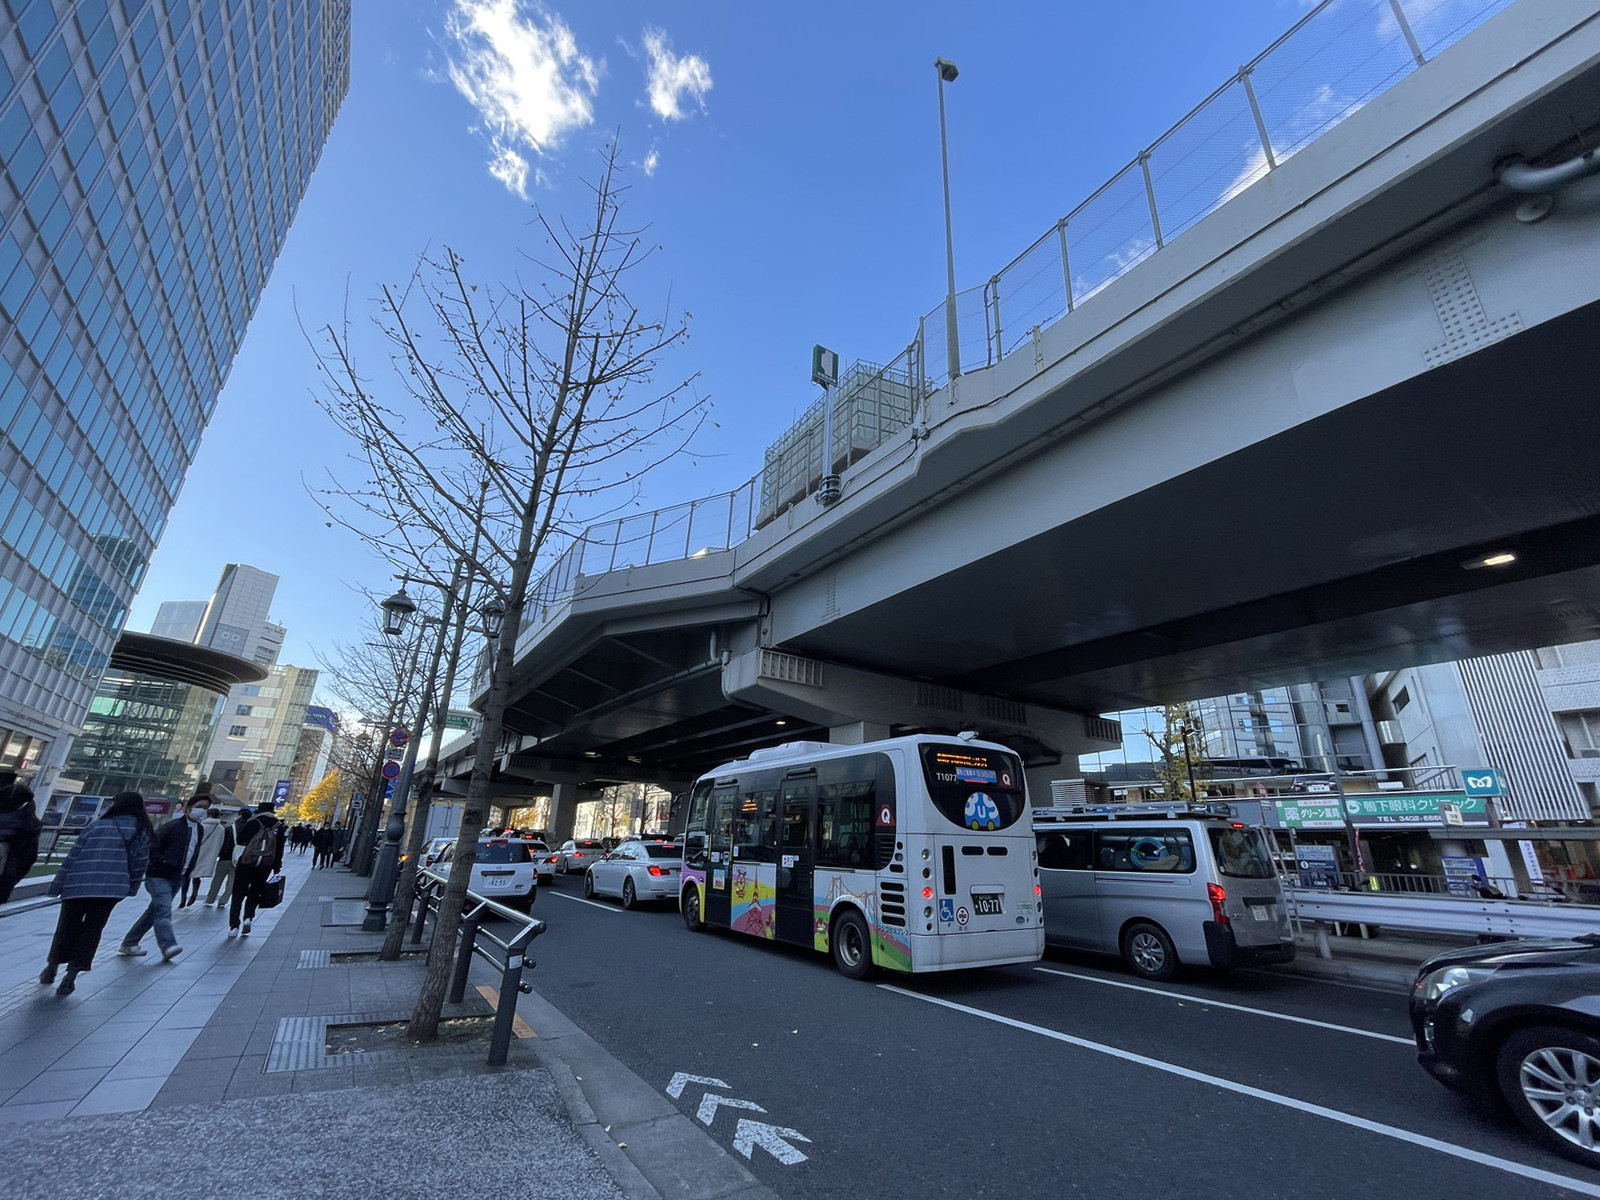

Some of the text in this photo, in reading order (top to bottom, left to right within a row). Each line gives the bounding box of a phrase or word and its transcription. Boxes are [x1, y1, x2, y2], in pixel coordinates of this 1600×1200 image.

[936, 772, 957, 782] T1077
[1284, 807, 1301, 821] 薬
[978, 899, 999, 913] 10-77
